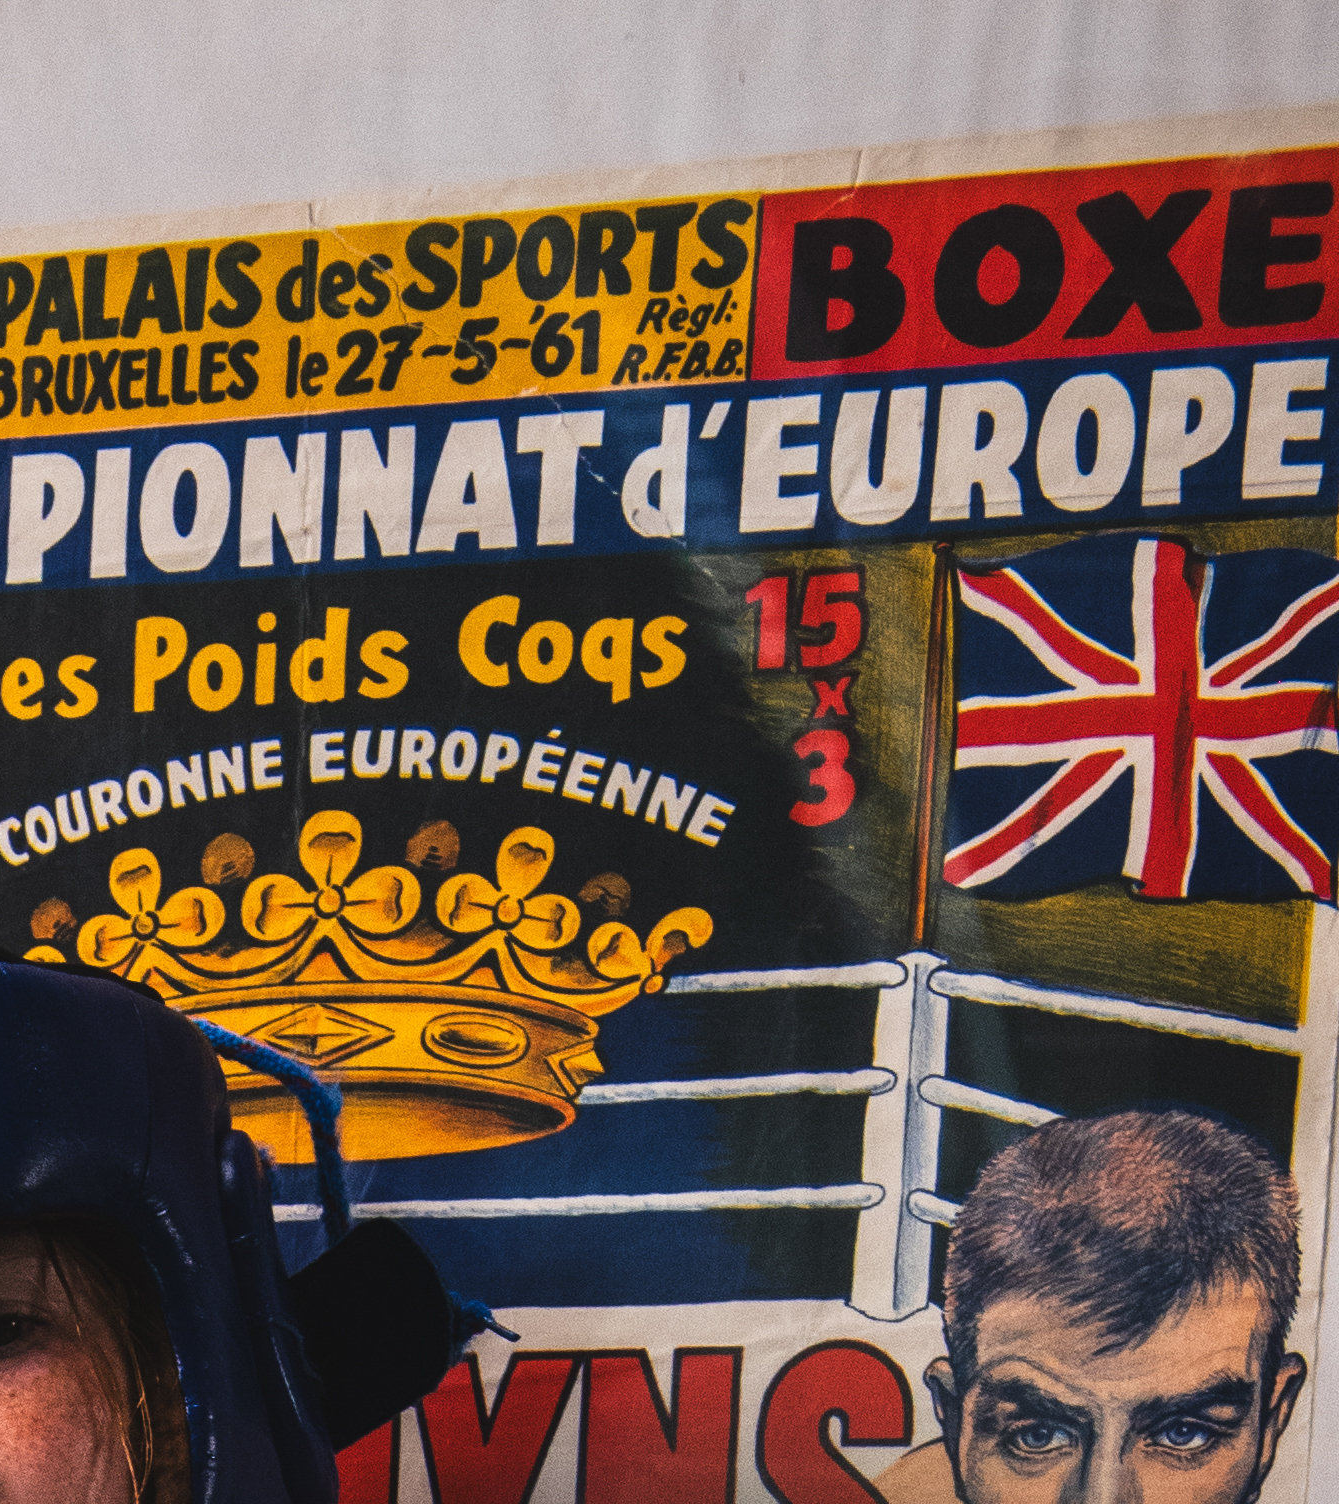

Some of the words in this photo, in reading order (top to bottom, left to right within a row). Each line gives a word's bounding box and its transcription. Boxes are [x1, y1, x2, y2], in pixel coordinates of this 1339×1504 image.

[275, 240, 392, 324] des
[403, 199, 753, 313] SPORTS
[784, 180, 1335, 362] BOXE
[620, 358, 1331, 540] d'EUROPE
[133, 608, 410, 713] Poids
[458, 594, 689, 704] Coqs
[745, 566, 866, 674] 15
[310, 728, 738, 848] EUROPÉENNE
[789, 730, 857, 828] 3
